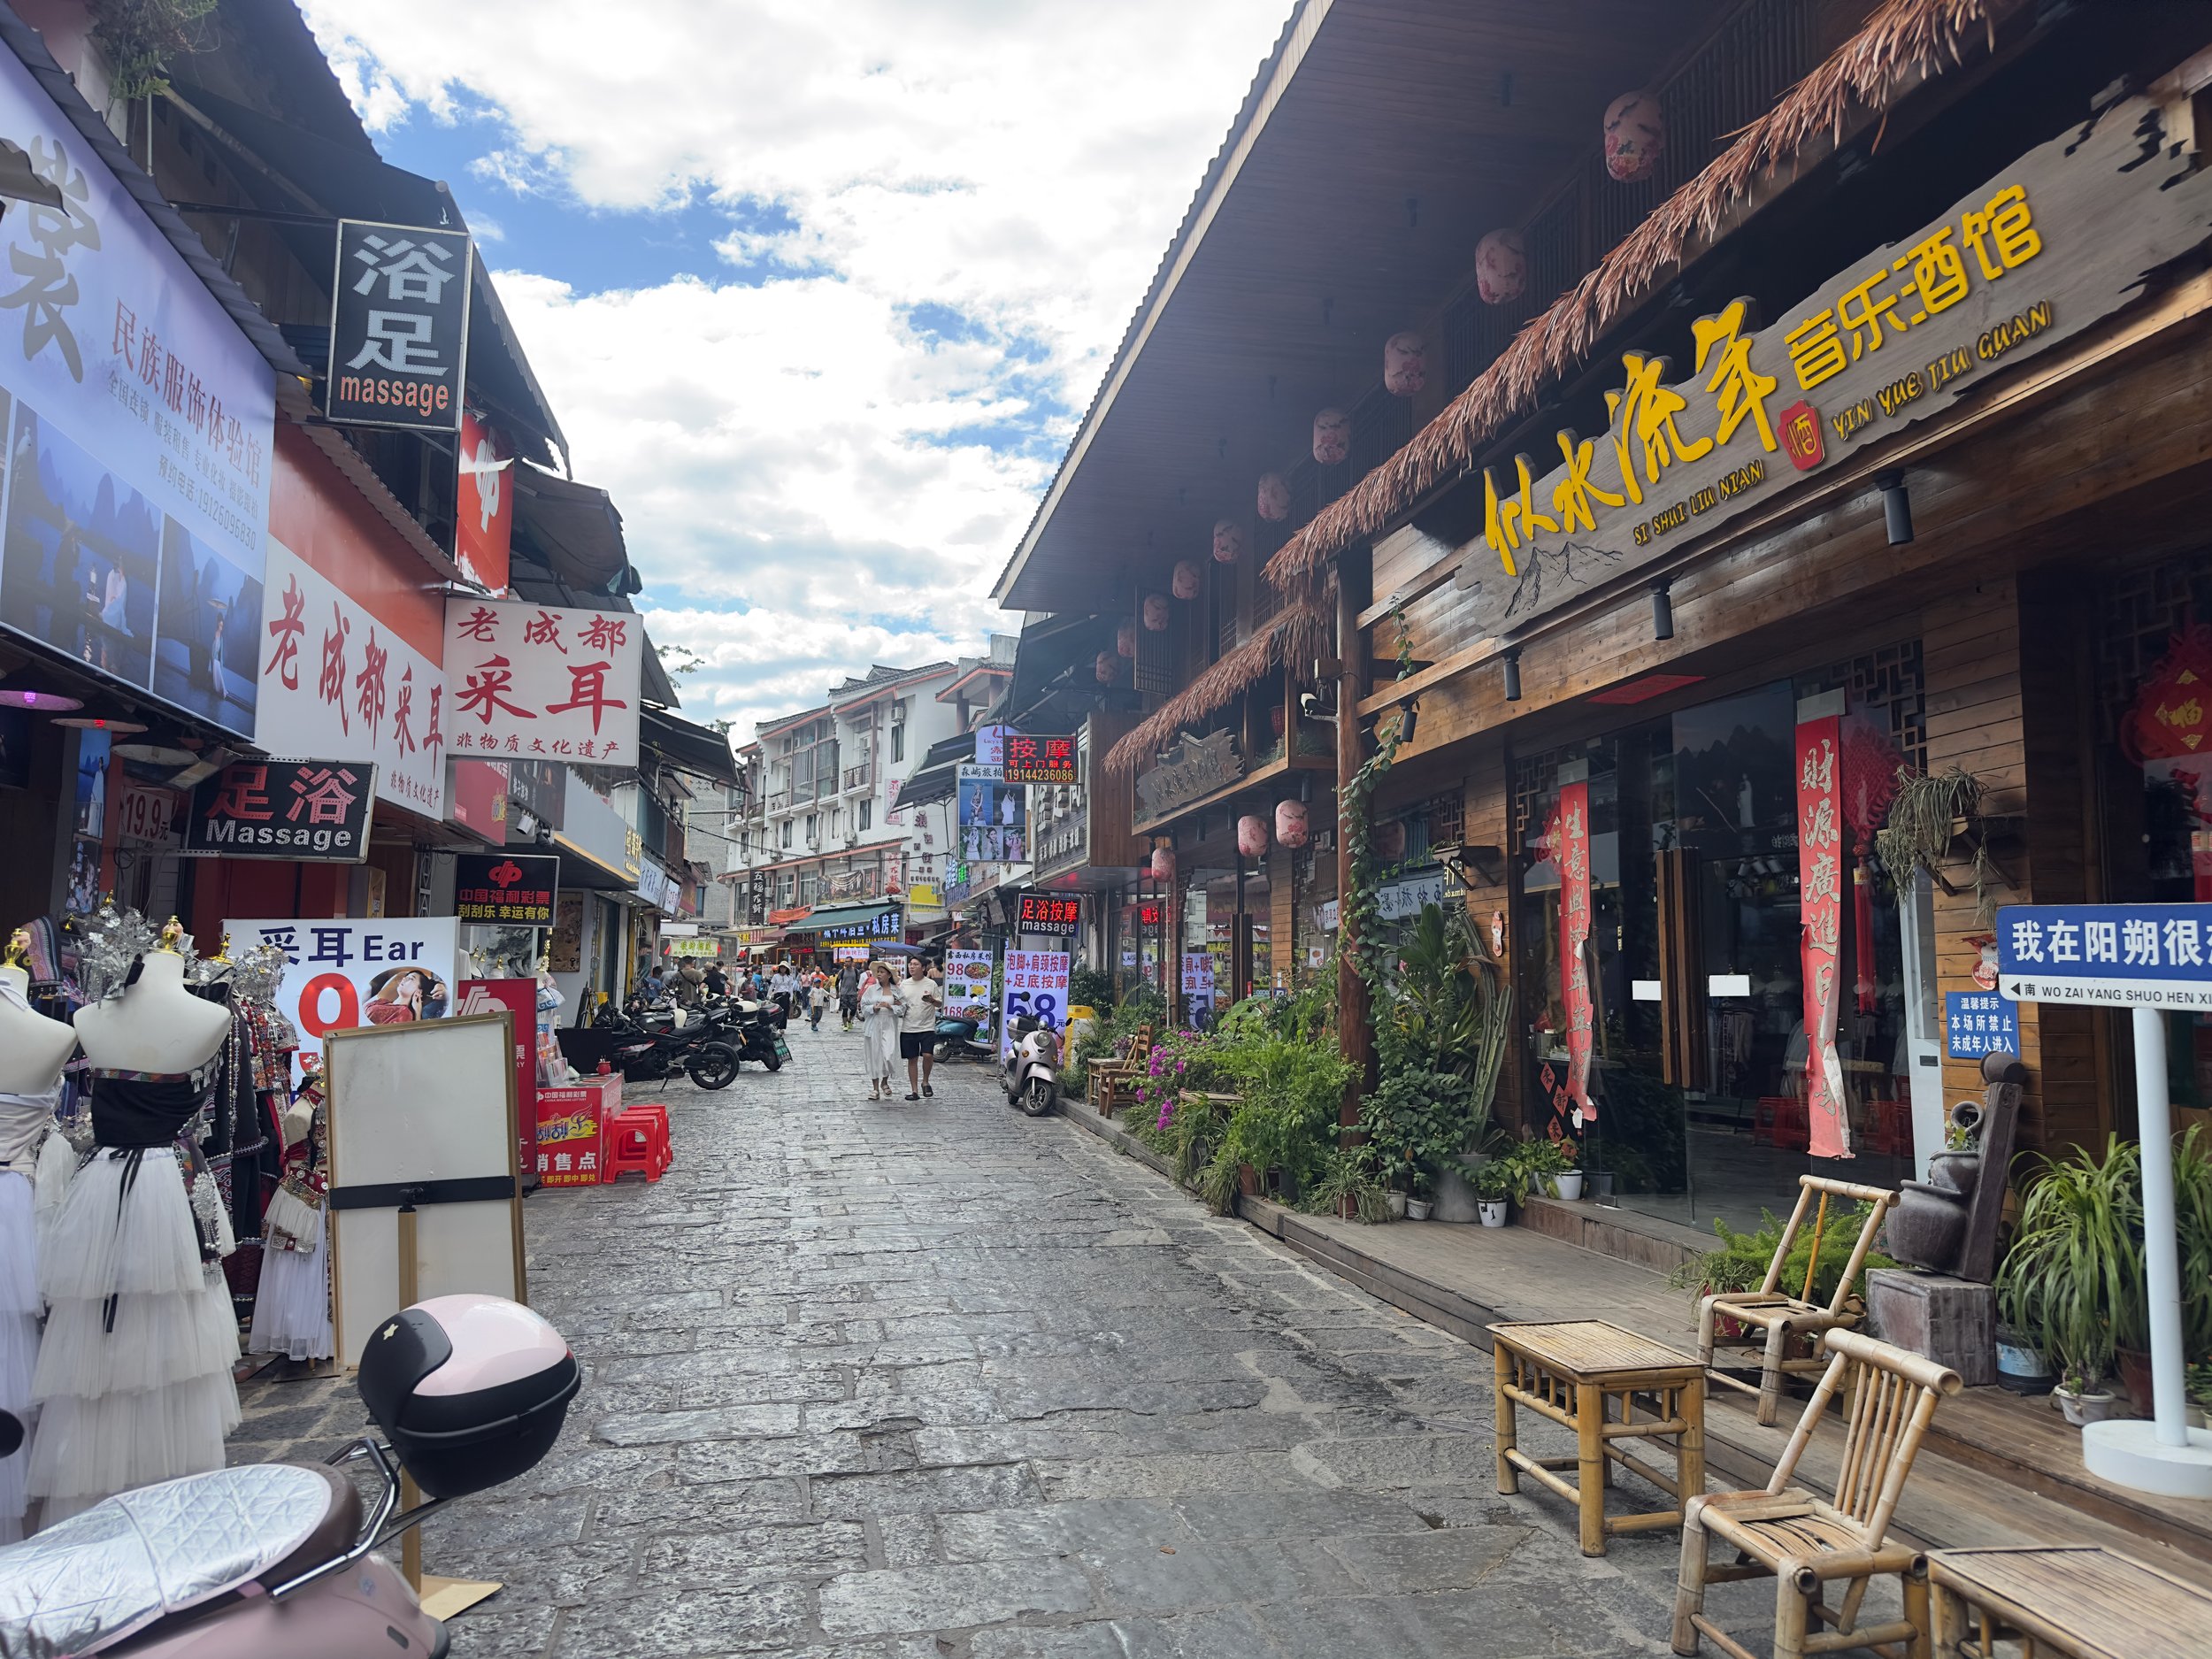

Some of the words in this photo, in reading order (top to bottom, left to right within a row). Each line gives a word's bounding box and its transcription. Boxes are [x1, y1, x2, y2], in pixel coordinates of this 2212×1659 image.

[1784, 184, 2041, 390] 音乐酒馆
[1832, 397, 1874, 441] YIN
[1877, 371, 1924, 418] YUE
[1926, 345, 1973, 392] JIU
[1977, 299, 2053, 360] GUAN
[107, 370, 149, 426] 全国连锁
[112, 296, 262, 489] 民族服饰体验馆
[340, 376, 449, 418] massage
[1484, 300, 1777, 576] 似水流年
[1633, 522, 1650, 545] SI
[1652, 498, 1687, 535] SHUI
[1690, 484, 1717, 516] LIU
[1718, 458, 1764, 500] NIAN
[457, 606, 626, 657] 老成都
[265, 572, 443, 780] 老成都采耳
[455, 653, 627, 736] 采耳
[457, 731, 619, 759] 非物质文化遗产
[1010, 738, 1071, 758] 按摩
[1008, 759, 1072, 769] 可上门服务
[1008, 769, 1073, 781] 19144236086
[205, 764, 357, 825] 足浴
[390, 769, 440, 810] 非物质文化遗产
[205, 819, 352, 851] Massage
[459, 888, 550, 905] 中国福利彩票
[458, 904, 495, 919] 刮刮乐
[499, 906, 549, 920] 幸运有你
[872, 912, 900, 935] 私房菜
[1021, 899, 1078, 923] 足浴按摩
[1022, 920, 1075, 934] massage
[259, 926, 354, 968] 采耳
[364, 934, 425, 962] Ear
[2012, 918, 2212, 967] 我在阳朔很
[947, 963, 964, 976] 98
[1006, 953, 1069, 973] 泡脚+肩颈按摩
[1005, 974, 1068, 989] +足底按摩
[2024, 983, 2035, 996] 南
[2042, 987, 2061, 996] WO
[2065, 987, 2083, 998] ZAI
[2087, 988, 2122, 1000] YANG
[2126, 990, 2162, 1002] SHUO
[2168, 992, 2193, 1003] HEN
[944, 1006, 962, 1018] 168
[1007, 992, 1056, 1027] 58
[1961, 997, 2000, 1010] 温馨提示
[1951, 1013, 2013, 1032] 本场所禁止
[1952, 1034, 2014, 1053] 未成年人进入
[547, 1174, 561, 1184] 即开
[564, 1173, 579, 1183] 即中
[580, 1173, 596, 1183] 即兑
